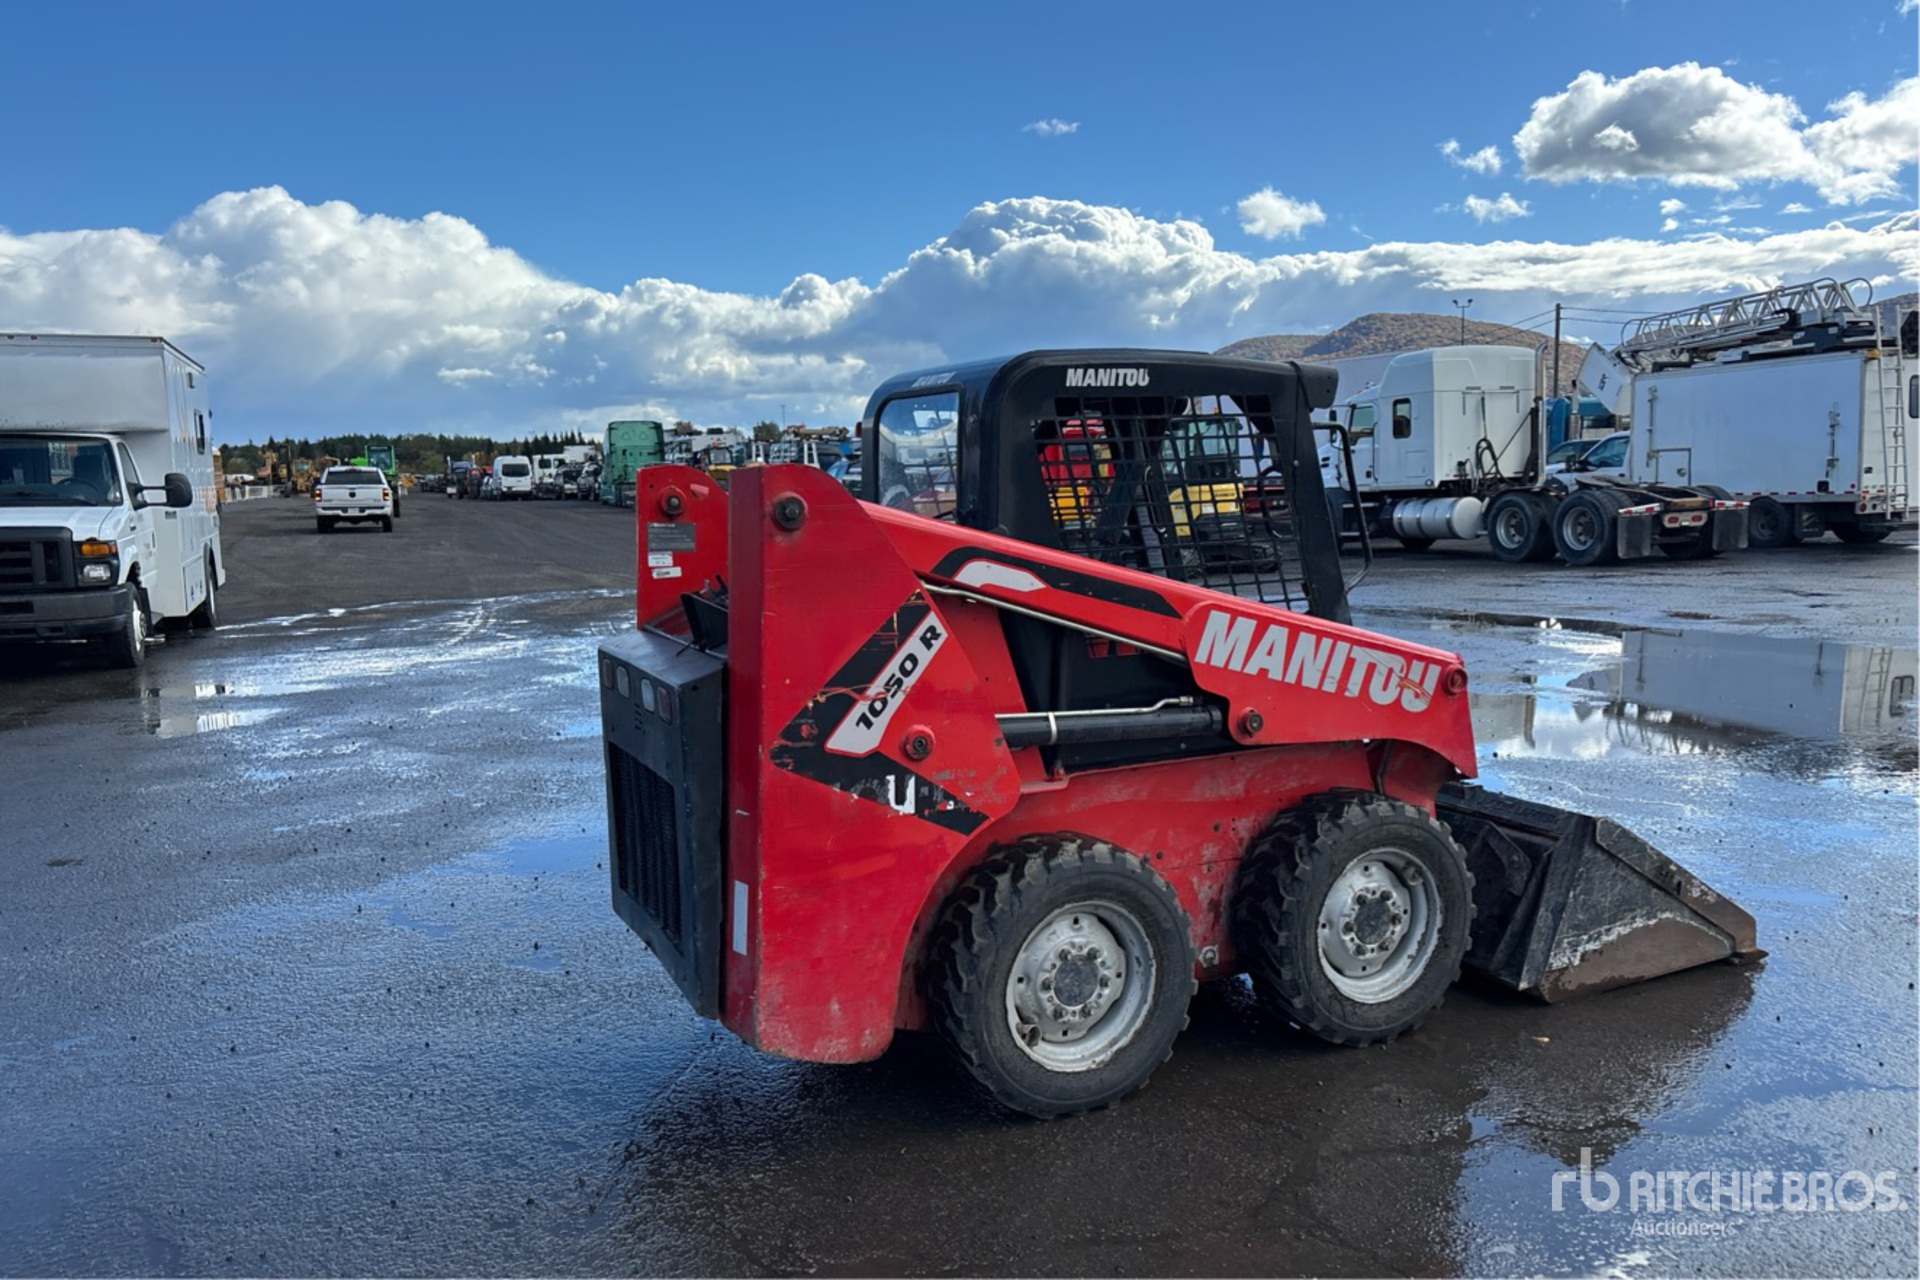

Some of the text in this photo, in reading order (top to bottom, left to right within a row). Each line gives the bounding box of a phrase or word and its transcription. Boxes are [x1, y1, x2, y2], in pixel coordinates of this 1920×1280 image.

[1065, 367, 1150, 388] MANITOU
[855, 624, 942, 731] 1050 R
[1194, 609, 1442, 713] MANITOU
